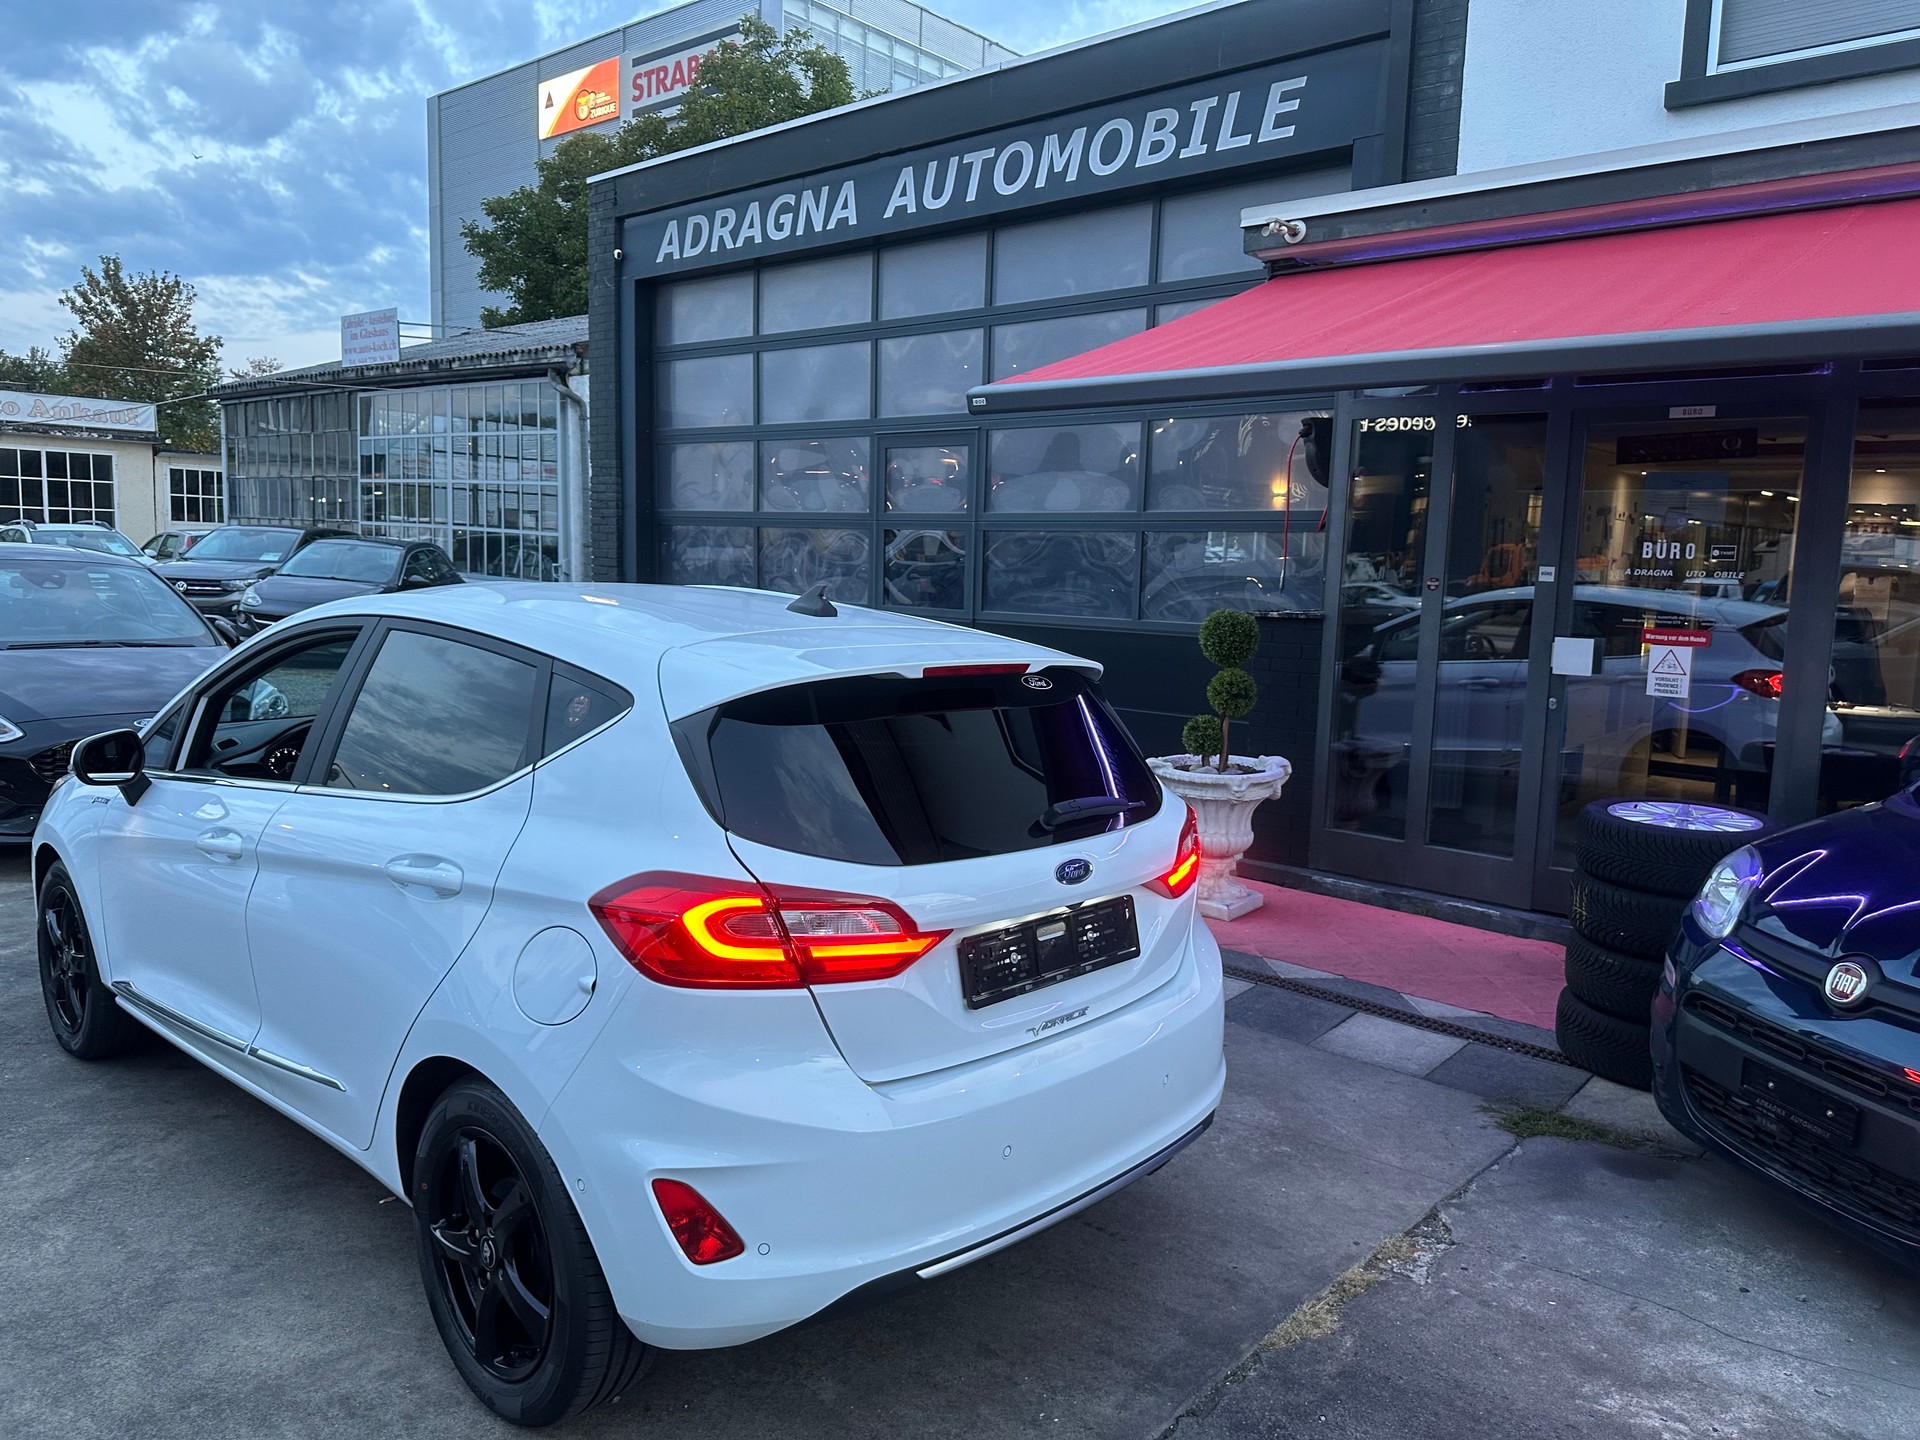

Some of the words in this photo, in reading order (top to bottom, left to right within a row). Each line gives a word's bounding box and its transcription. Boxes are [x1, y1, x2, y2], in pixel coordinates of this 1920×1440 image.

[656, 180, 859, 263] ADRAGNA
[884, 76, 1308, 221] AUTOMOBILE
[0, 401, 20, 415] o
[28, 398, 139, 426] Ankauf
[1641, 539, 1696, 560] BÜRO
[1645, 633, 1668, 641] Warnung
[1028, 677, 1047, 687] Ford
[1832, 971, 1859, 994] FIAT
